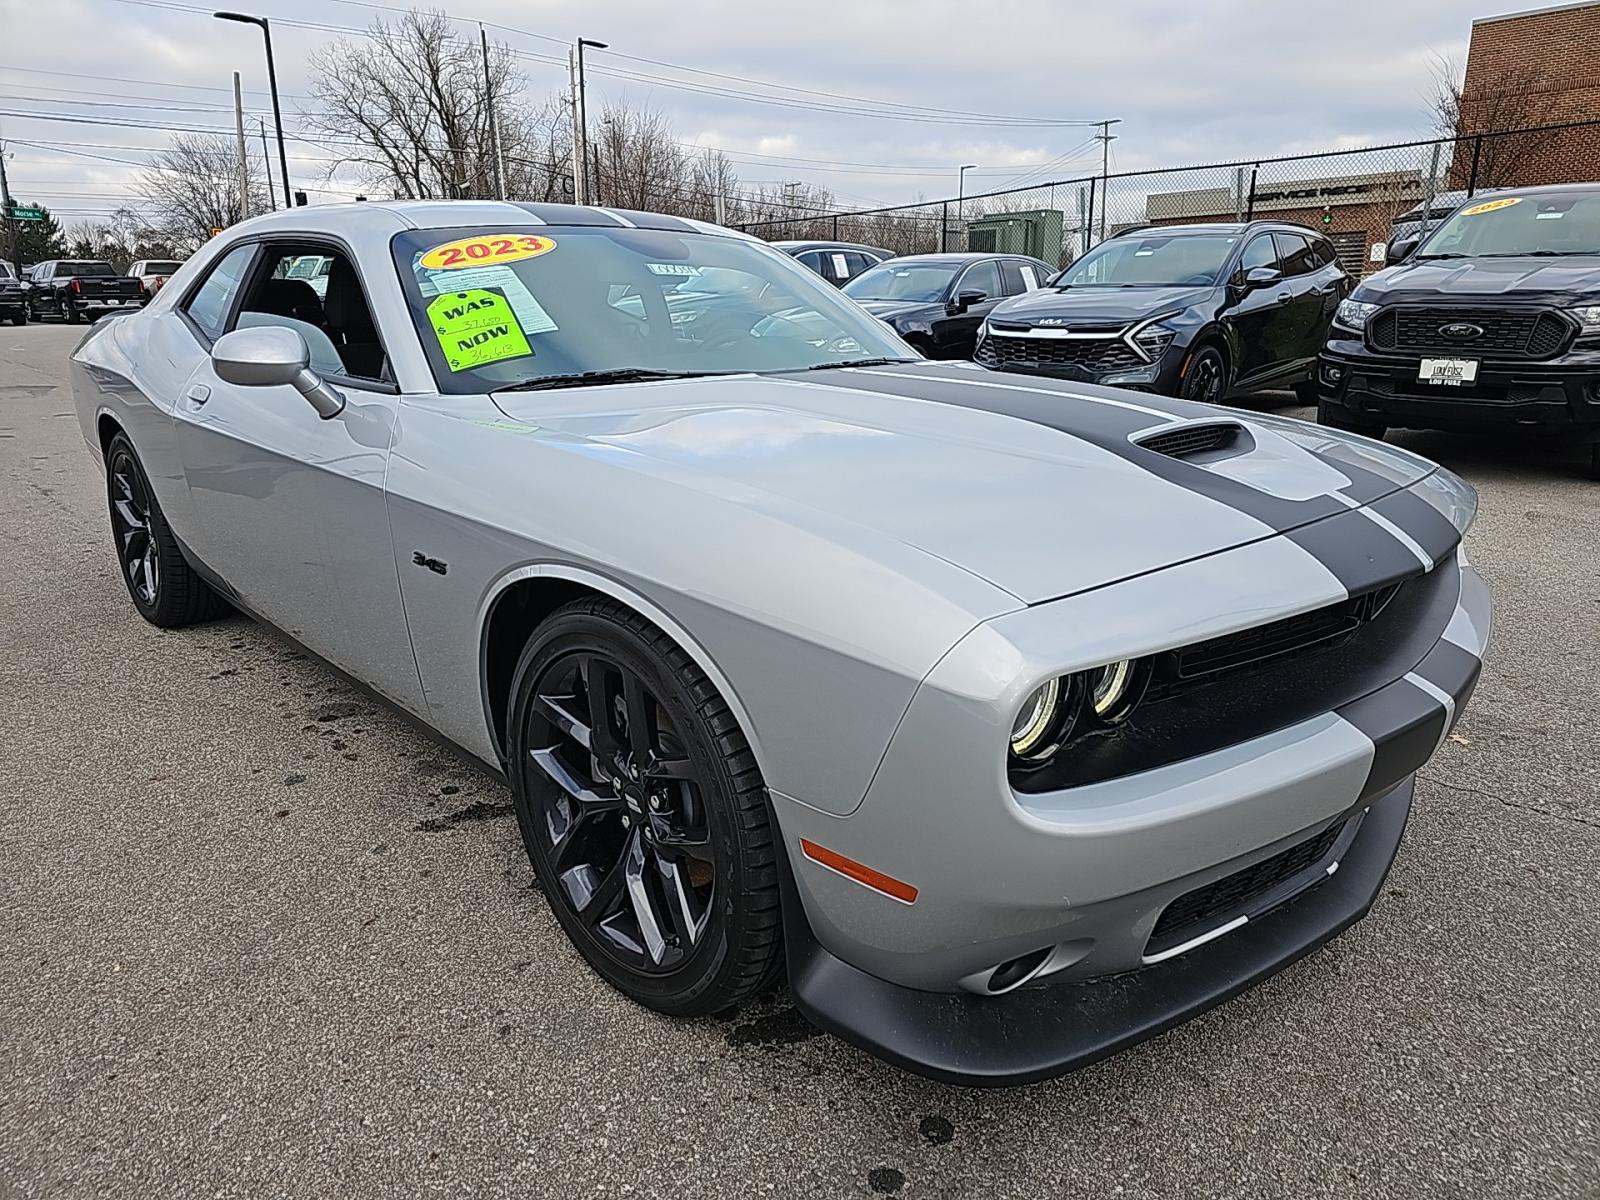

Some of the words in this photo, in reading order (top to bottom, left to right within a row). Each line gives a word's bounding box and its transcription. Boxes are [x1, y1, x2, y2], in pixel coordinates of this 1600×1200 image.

[438, 237, 544, 266] 2023
[442, 297, 495, 320] WAS
[457, 324, 509, 352] NOW
[412, 550, 448, 576] 345
